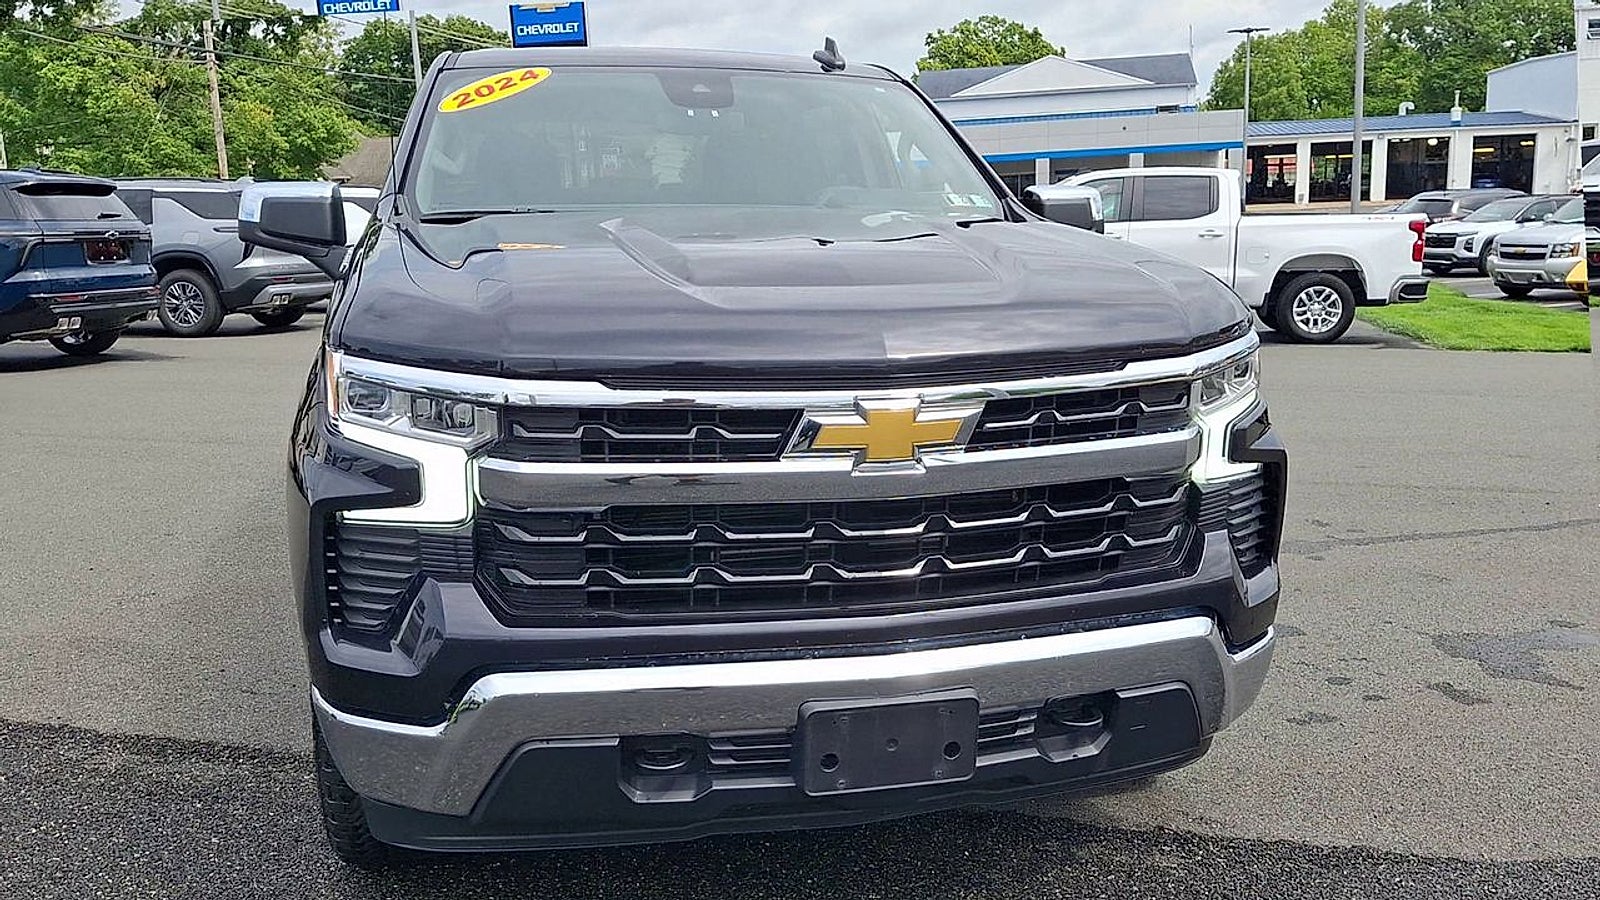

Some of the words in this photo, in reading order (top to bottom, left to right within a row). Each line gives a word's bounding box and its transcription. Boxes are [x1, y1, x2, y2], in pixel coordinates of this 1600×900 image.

[323, 0, 391, 14] CHEVROLET
[517, 22, 579, 36] CHEVROLET
[452, 69, 540, 108] 2024
